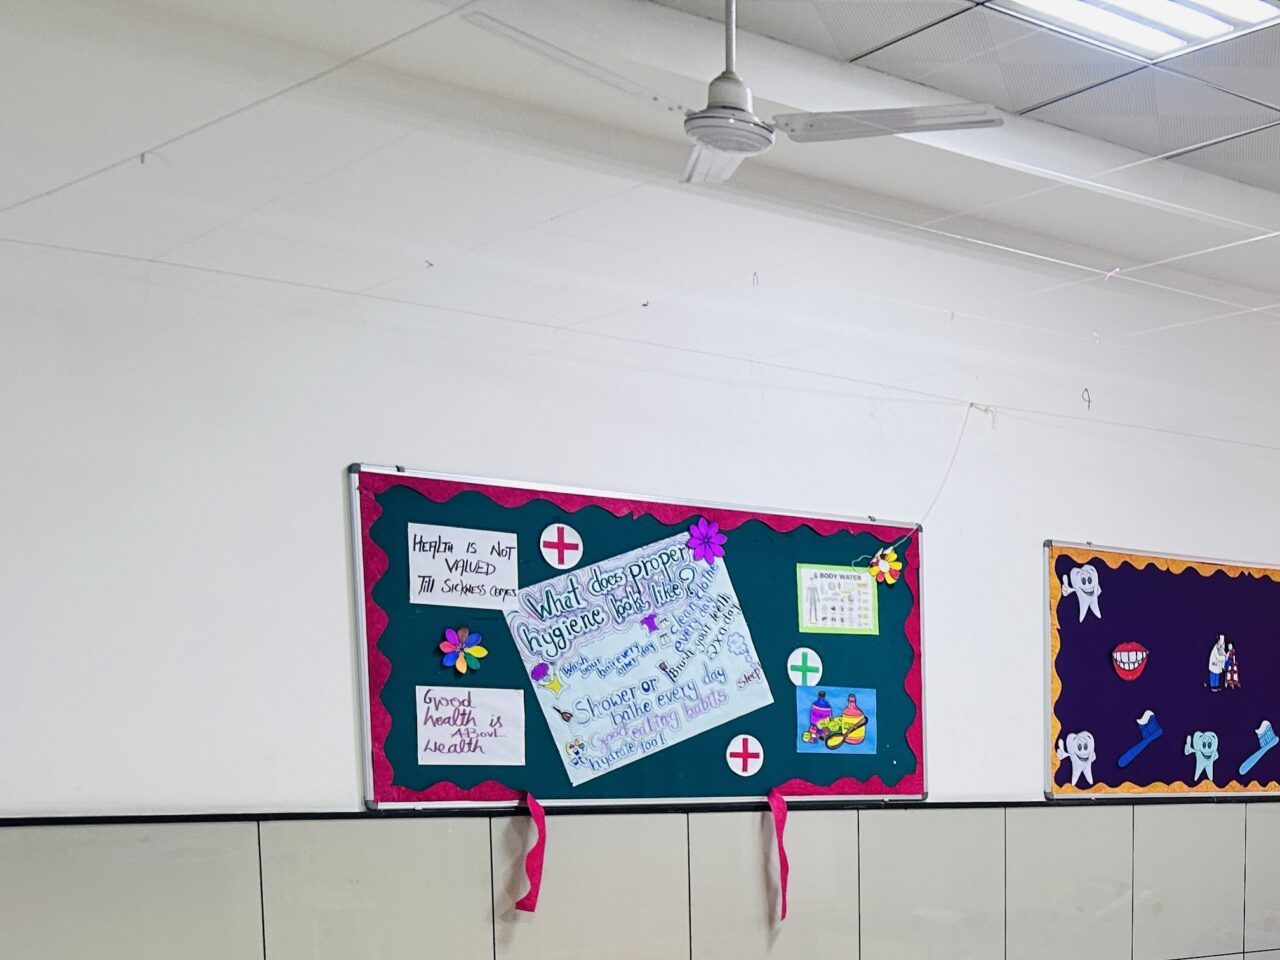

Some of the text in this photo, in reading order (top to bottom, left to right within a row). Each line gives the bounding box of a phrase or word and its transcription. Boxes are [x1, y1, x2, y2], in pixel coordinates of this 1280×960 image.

[413, 534, 516, 560] HEALTH IS NOT
[445, 558, 496, 576] VALUED
[525, 545, 687, 621] What does proper
[522, 610, 605, 658] hygiene
[610, 590, 646, 619] look
[671, 601, 698, 634] clean
[675, 595, 719, 653] every day
[695, 624, 711, 653] your
[709, 594, 731, 622] teeth
[722, 603, 741, 625] day
[562, 656, 589, 677] Wash
[580, 658, 601, 679] your
[596, 643, 640, 678] hair every
[618, 641, 657, 675] other day
[423, 688, 476, 711] Good
[575, 678, 658, 724] Shower or
[611, 661, 728, 726] bathe every day
[423, 706, 503, 728] health is
[590, 689, 728, 749] Good eating habits
[588, 741, 635, 771] hydrate
